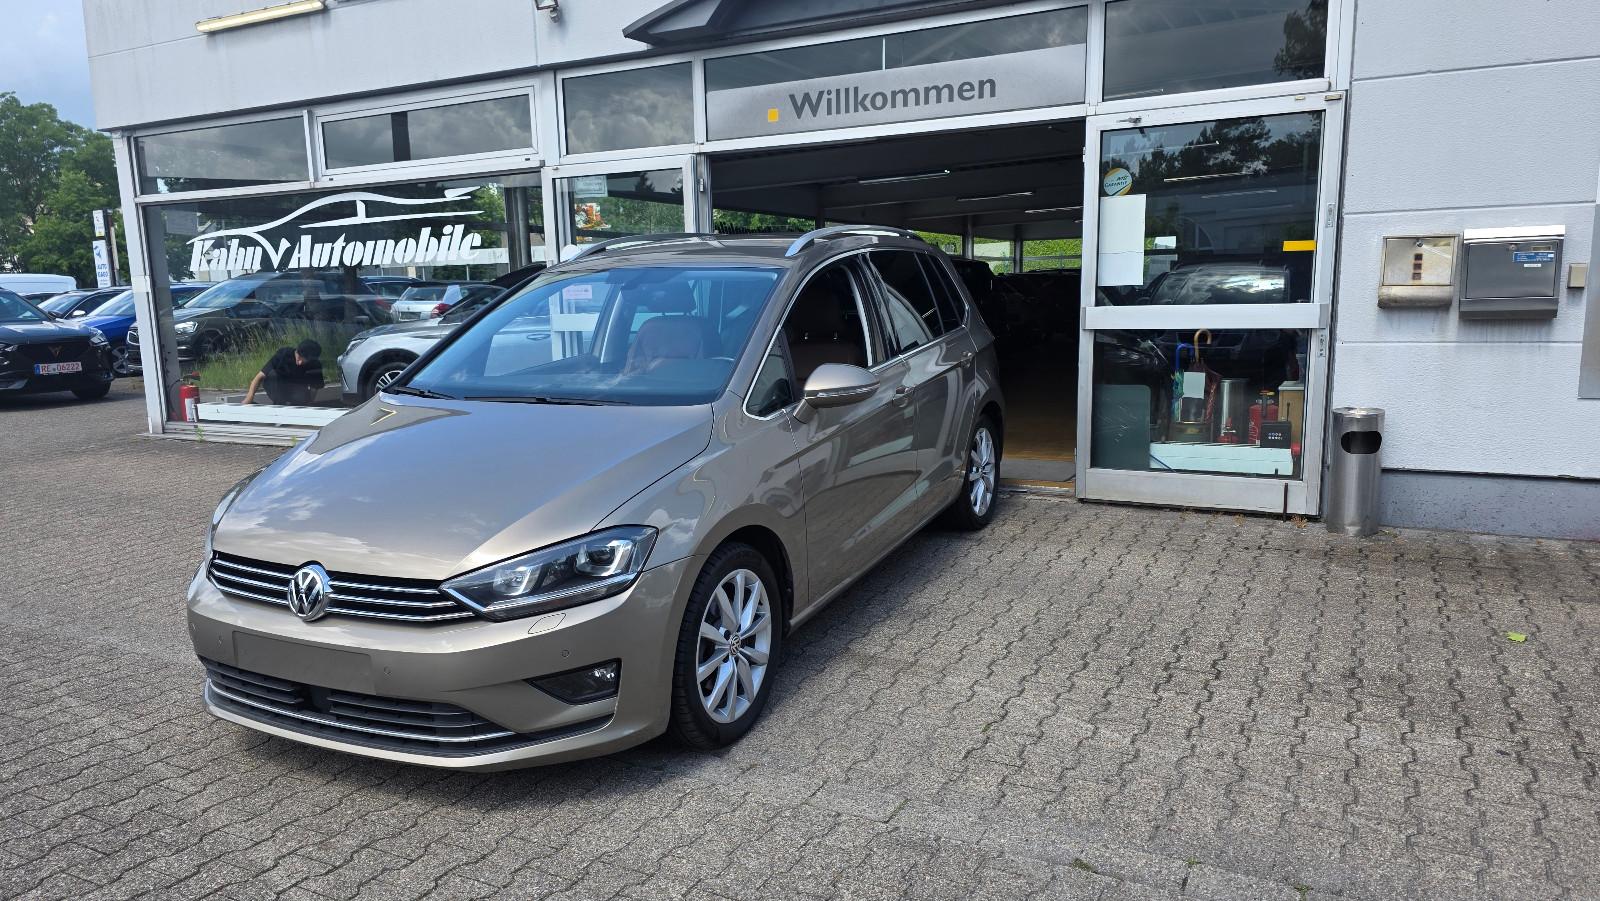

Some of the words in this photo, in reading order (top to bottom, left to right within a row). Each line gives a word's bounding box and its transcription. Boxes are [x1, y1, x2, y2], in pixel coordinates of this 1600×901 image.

[788, 78, 997, 119] Willkommen
[190, 238, 263, 271] Kahn
[288, 223, 482, 269] Automobile
